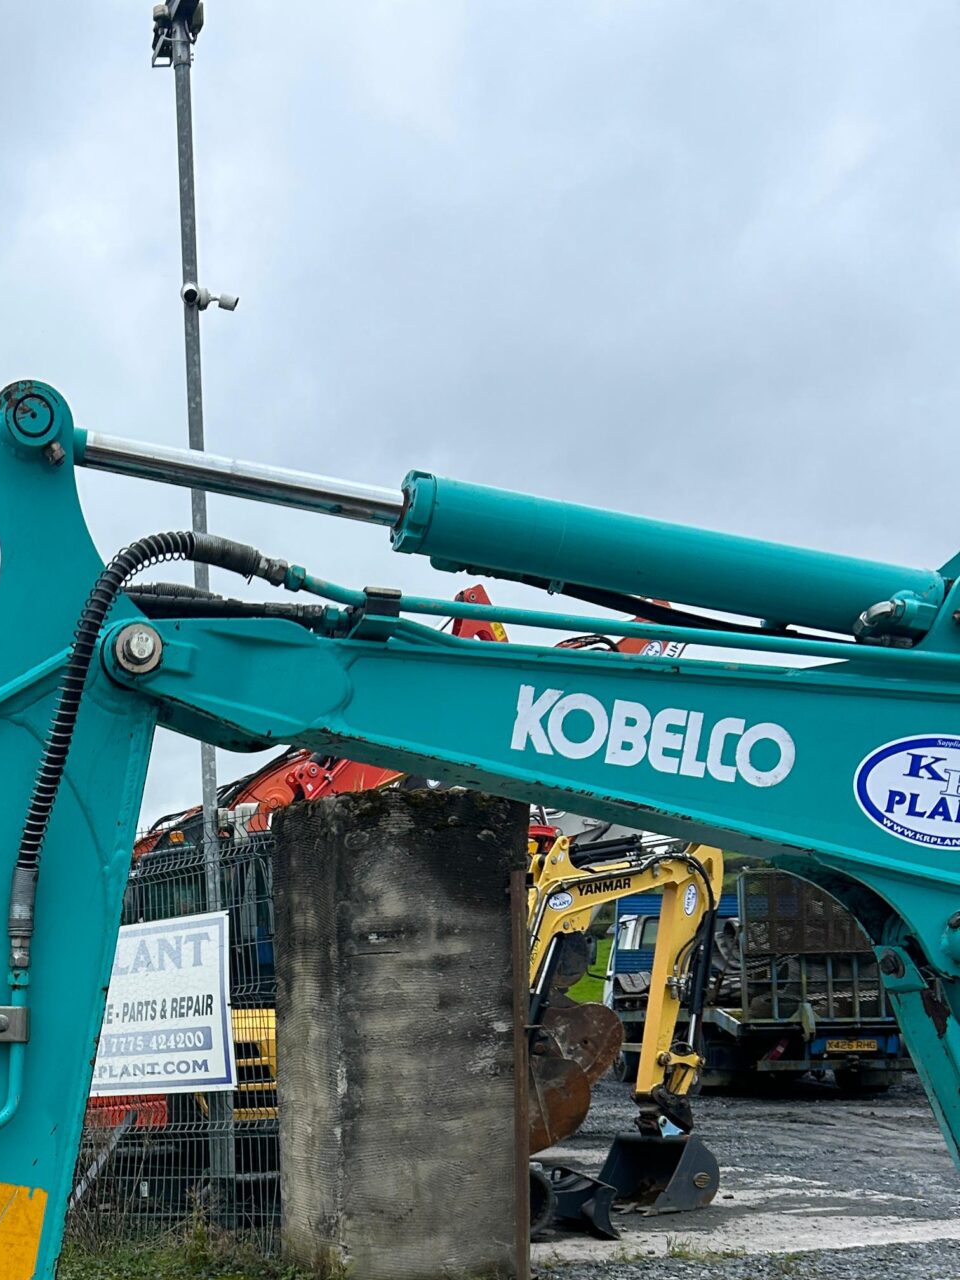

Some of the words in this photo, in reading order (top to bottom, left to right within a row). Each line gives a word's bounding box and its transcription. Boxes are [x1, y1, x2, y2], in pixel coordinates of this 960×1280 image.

[510, 684, 796, 788] KOBELCO
[884, 789, 960, 824] PLA
[577, 877, 632, 897] YANMAR
[103, 1003, 114, 1025] E
[122, 1000, 158, 1024] PARTS
[159, 998, 168, 1020] &
[170, 994, 214, 1019] REPAIR
[110, 1035, 145, 1054] 7775
[149, 1030, 205, 1051] 424200
[94, 1059, 210, 1081] PLANT.COM
